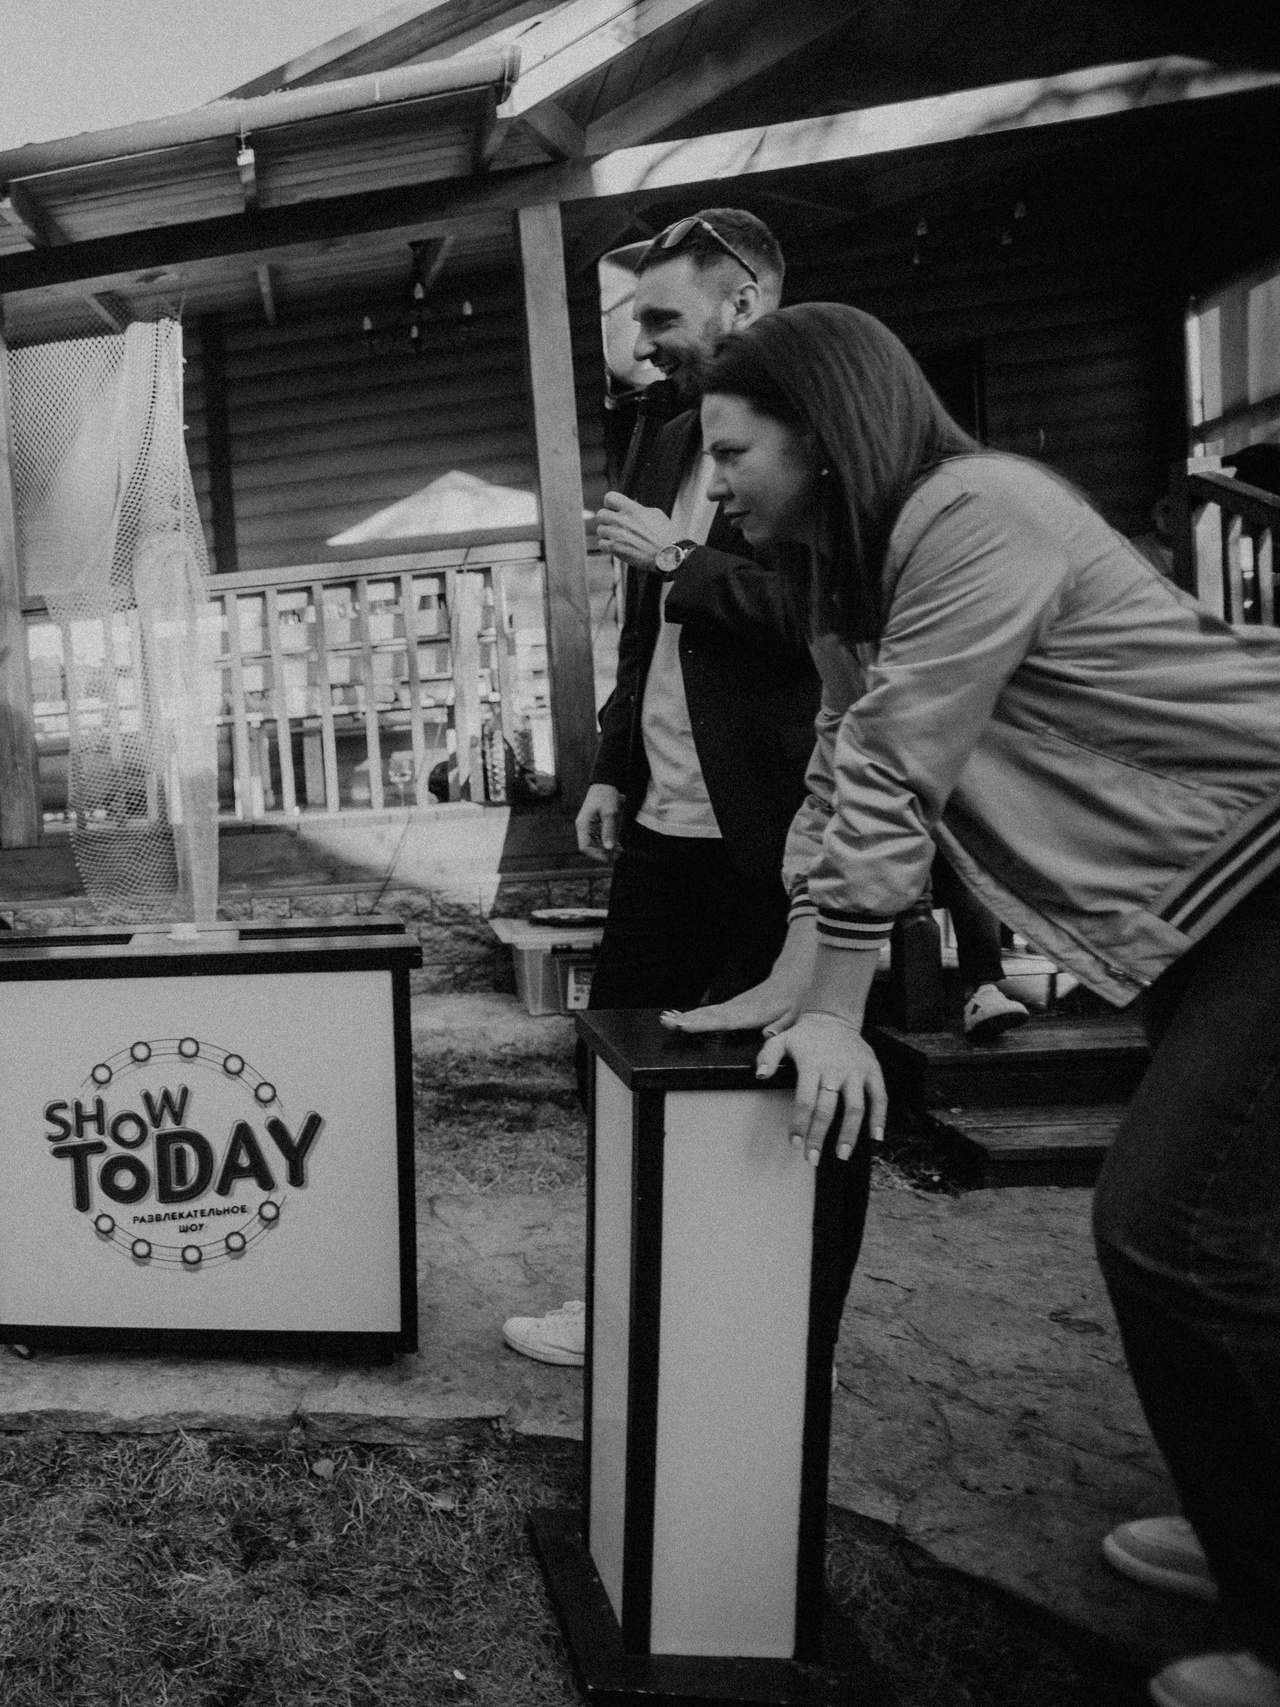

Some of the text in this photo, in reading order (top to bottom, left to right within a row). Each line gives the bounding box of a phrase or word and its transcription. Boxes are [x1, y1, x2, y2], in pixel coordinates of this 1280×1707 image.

[43, 1083, 189, 1149] SHOW
[50, 1110, 323, 1212] TODAY
[132, 1204, 248, 1224] РАЗВЛЕКАТЕЛЬНОЕ
[178, 1223, 205, 1233] ШОУ
